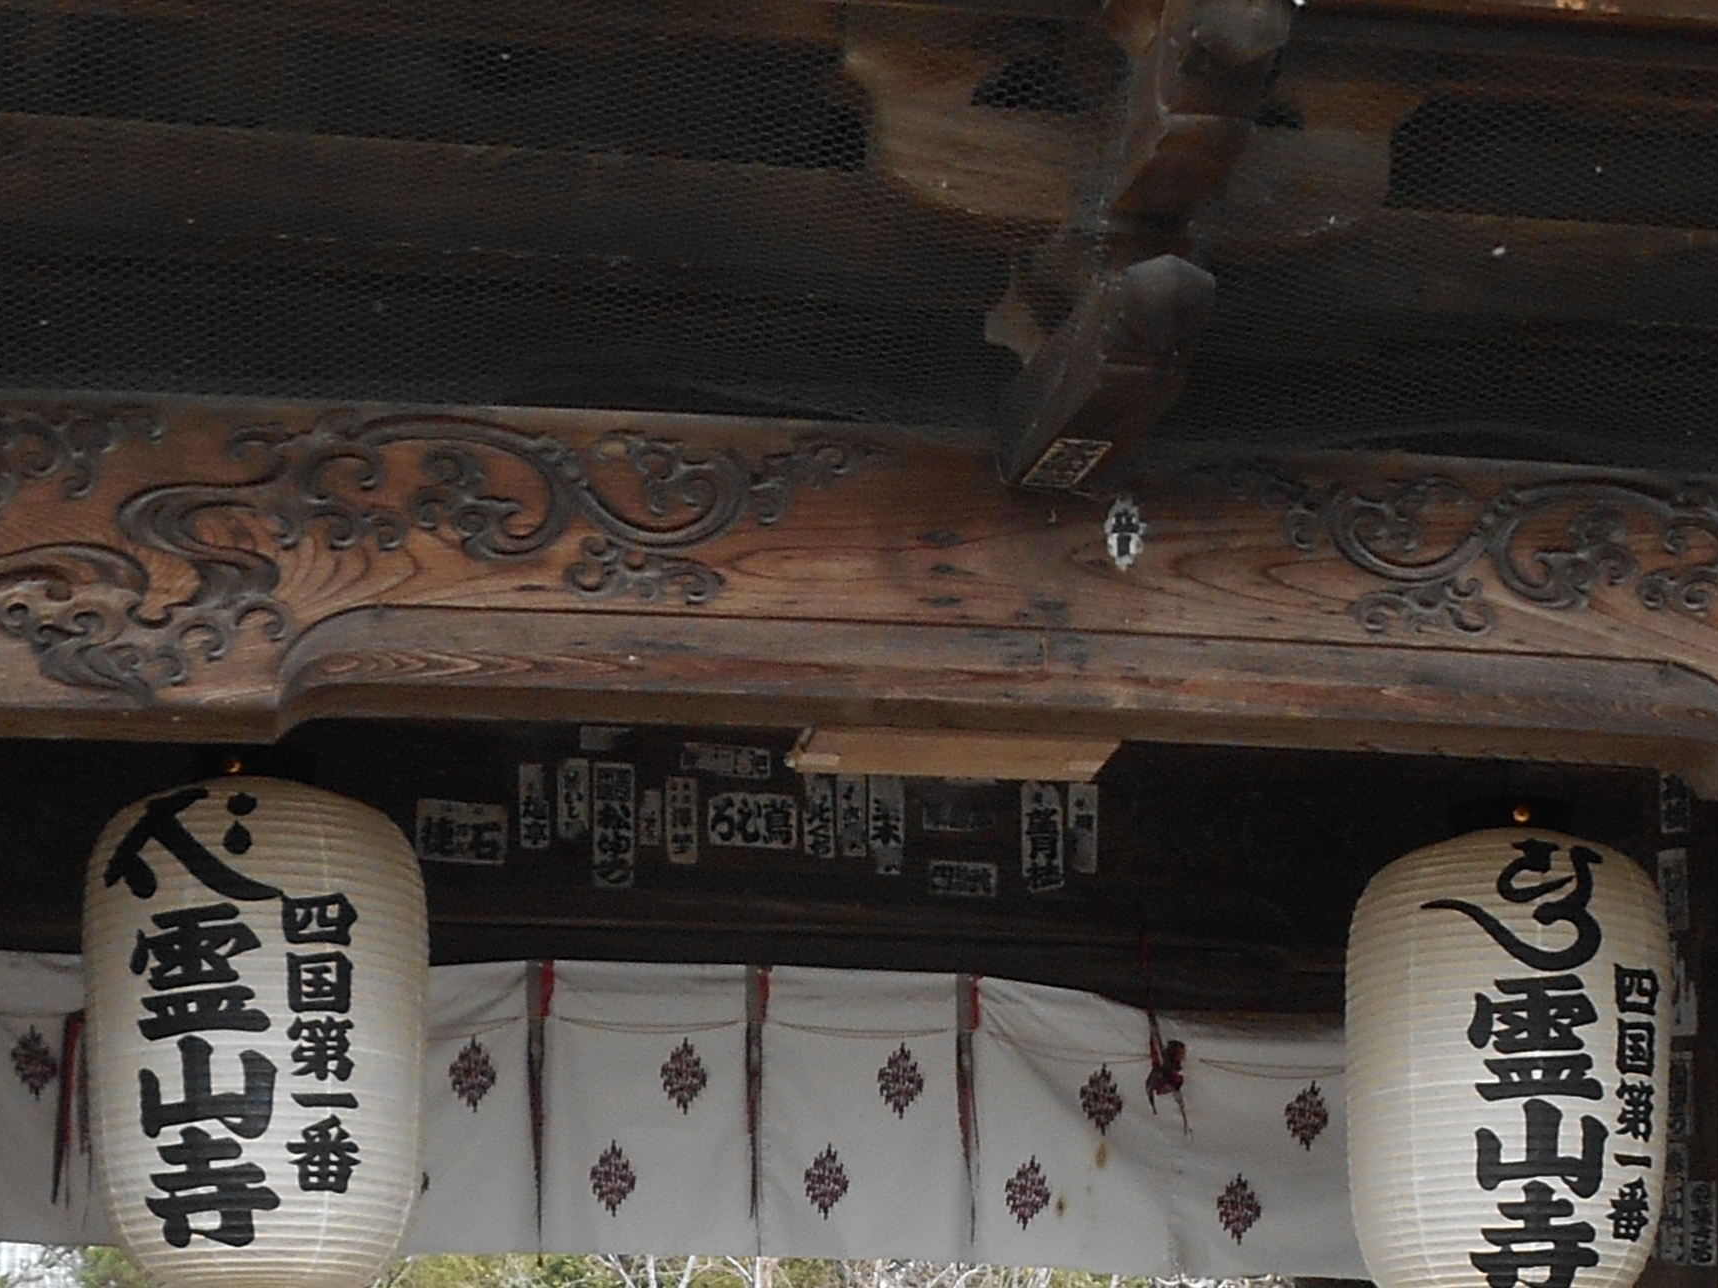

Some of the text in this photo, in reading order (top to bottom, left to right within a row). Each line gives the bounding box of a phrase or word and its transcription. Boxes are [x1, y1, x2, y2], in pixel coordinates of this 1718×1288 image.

[129, 902, 281, 1247] 霊山寺
[282, 892, 361, 1194] 四国第一番
[1606, 963, 1661, 1244] 四国第一番
